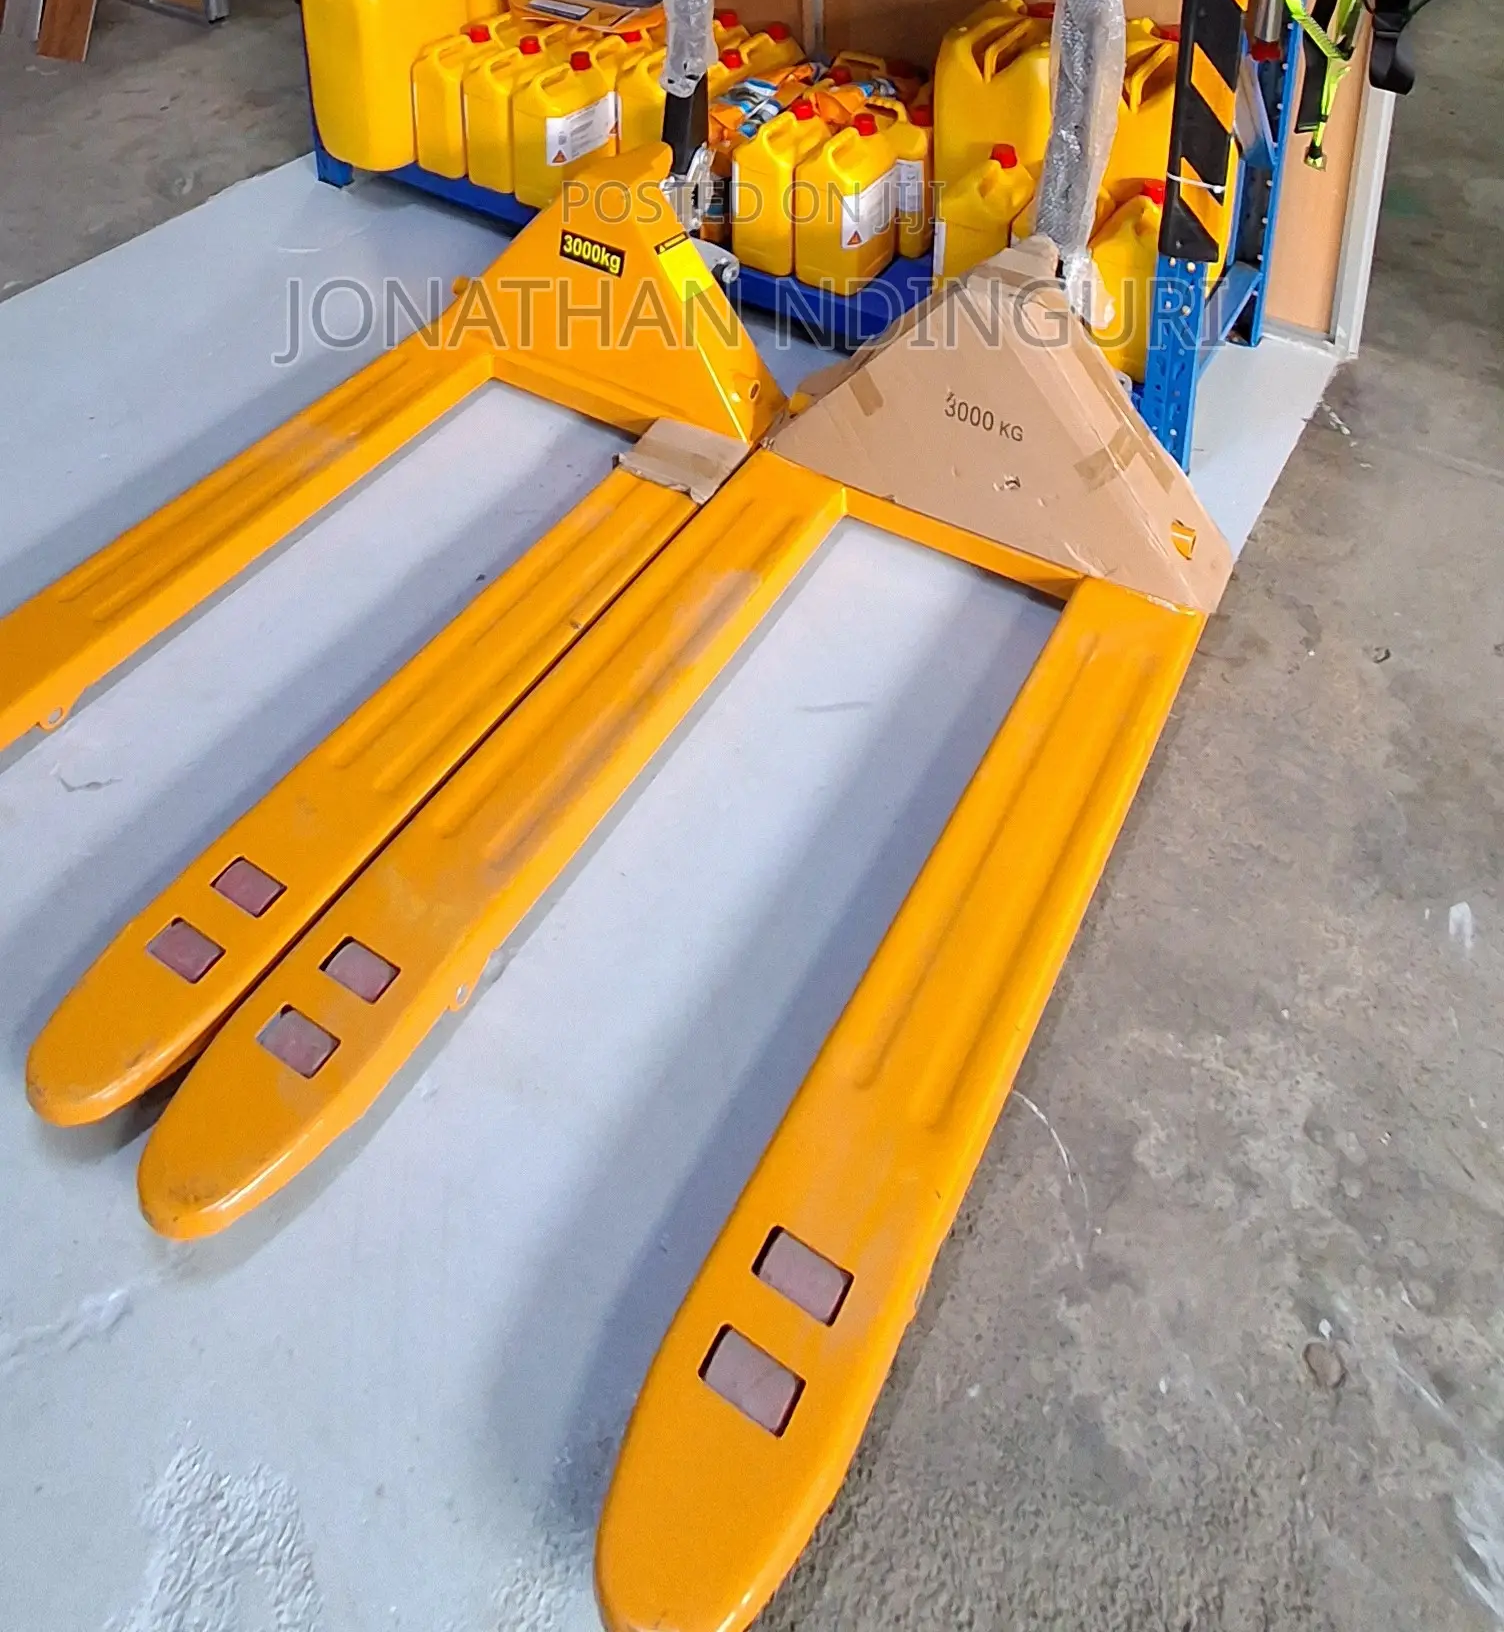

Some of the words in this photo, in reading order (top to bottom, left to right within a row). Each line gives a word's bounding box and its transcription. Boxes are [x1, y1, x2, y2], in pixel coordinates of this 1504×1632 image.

[561, 233, 623, 275] 3000kg
[944, 393, 995, 432] 3000
[998, 421, 1024, 443] KG
